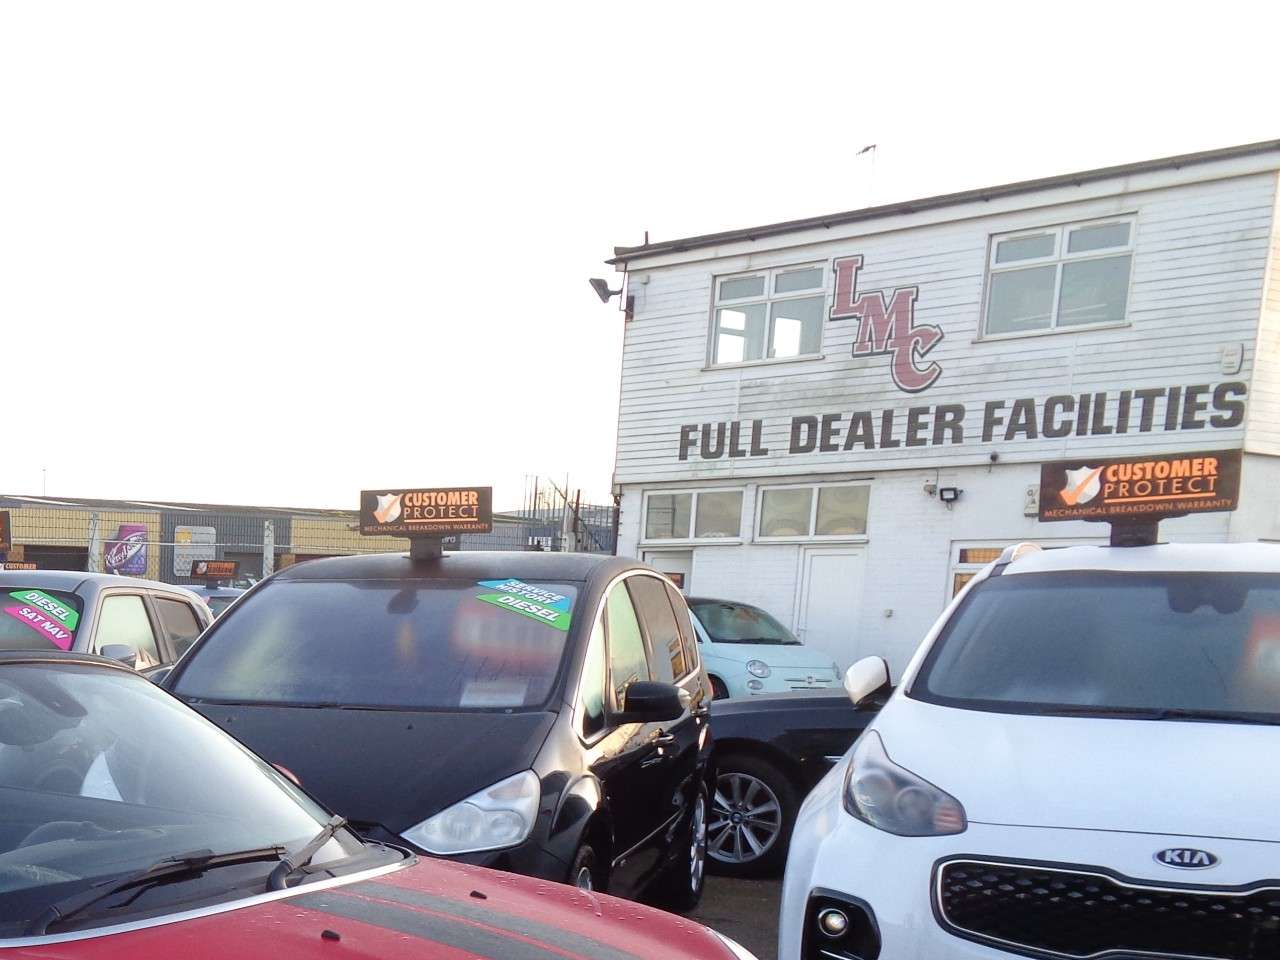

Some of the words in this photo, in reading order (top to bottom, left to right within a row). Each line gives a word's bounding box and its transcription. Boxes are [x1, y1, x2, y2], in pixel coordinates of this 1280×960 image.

[829, 254, 944, 393] LMC
[678, 419, 768, 461] FULL
[789, 404, 966, 455] DEALER
[982, 382, 1248, 442] FACILITIES
[1105, 458, 1219, 482] CUSTOMER
[1104, 476, 1219, 497] PROTECT
[404, 491, 479, 507] CUSTOMER
[1044, 507, 1107, 518] MECHANICAL
[1110, 503, 1173, 514] BREAKDOWN
[1177, 499, 1233, 509] WARRANTY
[403, 505, 480, 519] PROTECT
[364, 524, 407, 532] MECHANICAL
[408, 523, 451, 531] BREAKDOWN
[5, 562, 37, 570] CUSTOMER
[495, 583, 557, 605] HISTORY
[505, 580, 566, 601] SERVICE
[24, 591, 70, 621] DIESEL
[496, 595, 561, 622] DIESEL
[18, 607, 43, 626] SAT
[42, 620, 69, 640] NAV
[1164, 849, 1210, 865] KIA
